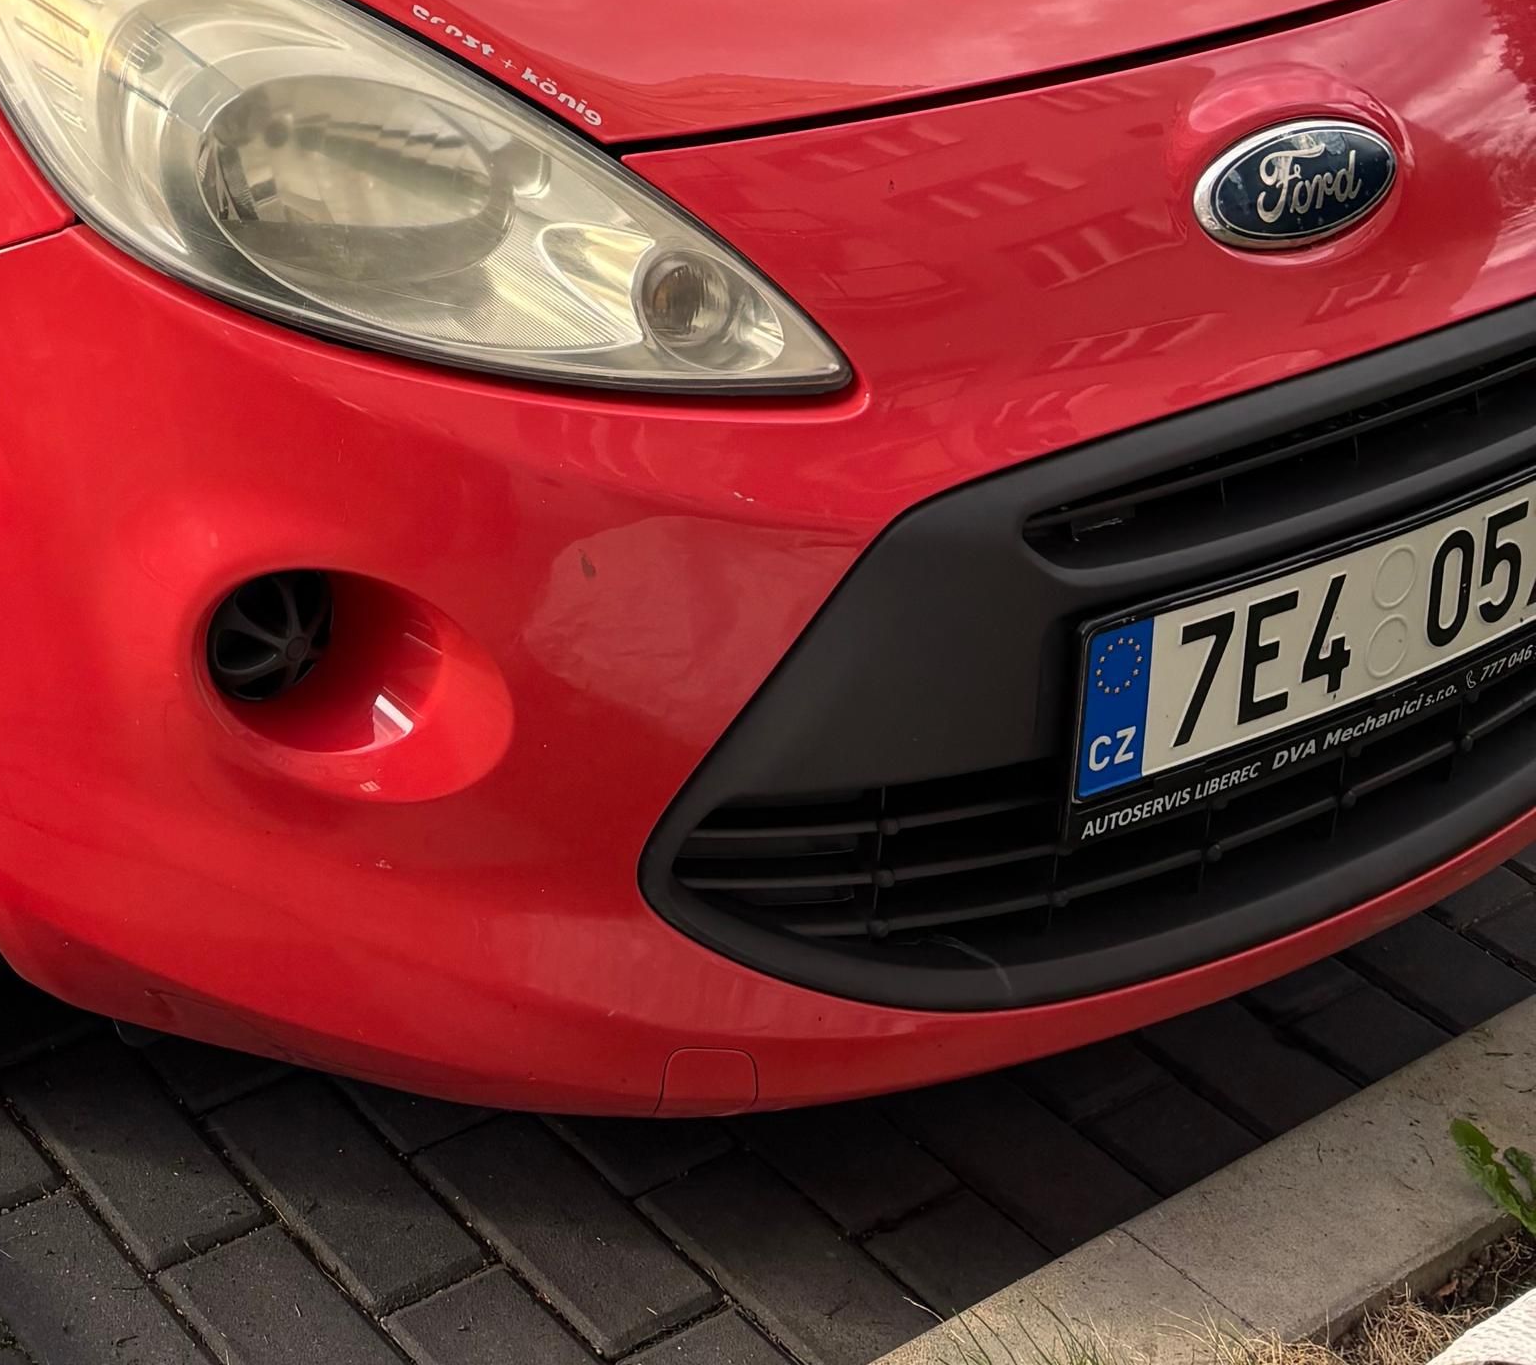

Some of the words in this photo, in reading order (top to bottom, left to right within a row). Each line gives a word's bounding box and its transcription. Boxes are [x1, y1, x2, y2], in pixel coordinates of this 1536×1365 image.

[412, 4, 495, 56] ernst
[521, 67, 602, 126] könig
[1256, 142, 1362, 223] Ford
[1170, 572, 1352, 748] 7E4
[1425, 499, 1536, 648] 05
[1081, 787, 1191, 840] AUTOSERVIS
[1194, 762, 1261, 800] LIBEREC
[1272, 739, 1316, 770] DVA
[1323, 693, 1423, 750] Mechanici
[1424, 684, 1457, 707] s.r.o.
[1480, 657, 1507, 682] 777
[1507, 644, 1534, 668] 046
[1088, 726, 1137, 771] CZ
